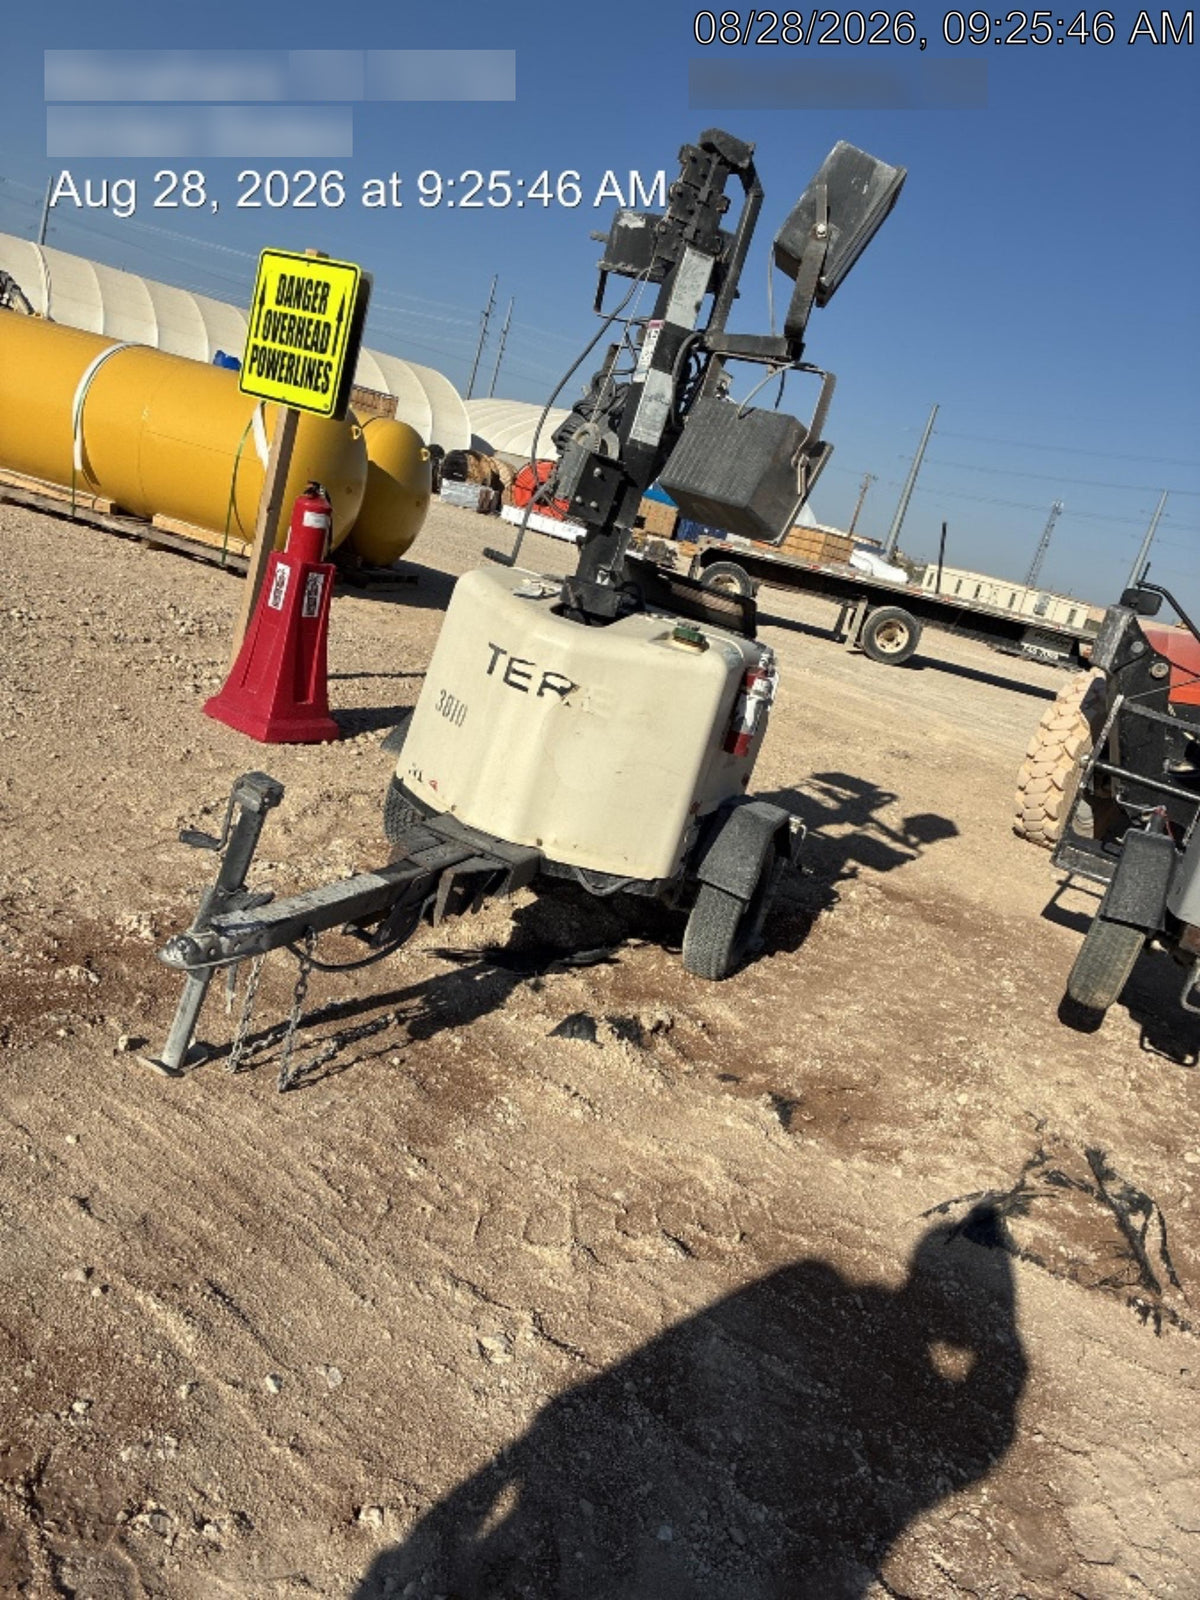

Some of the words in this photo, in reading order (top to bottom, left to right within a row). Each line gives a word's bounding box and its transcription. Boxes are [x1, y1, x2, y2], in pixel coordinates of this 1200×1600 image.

[275, 273, 331, 315] DANGER
[262, 309, 332, 355] OVERHEAD
[249, 343, 333, 395] POWERLINES
